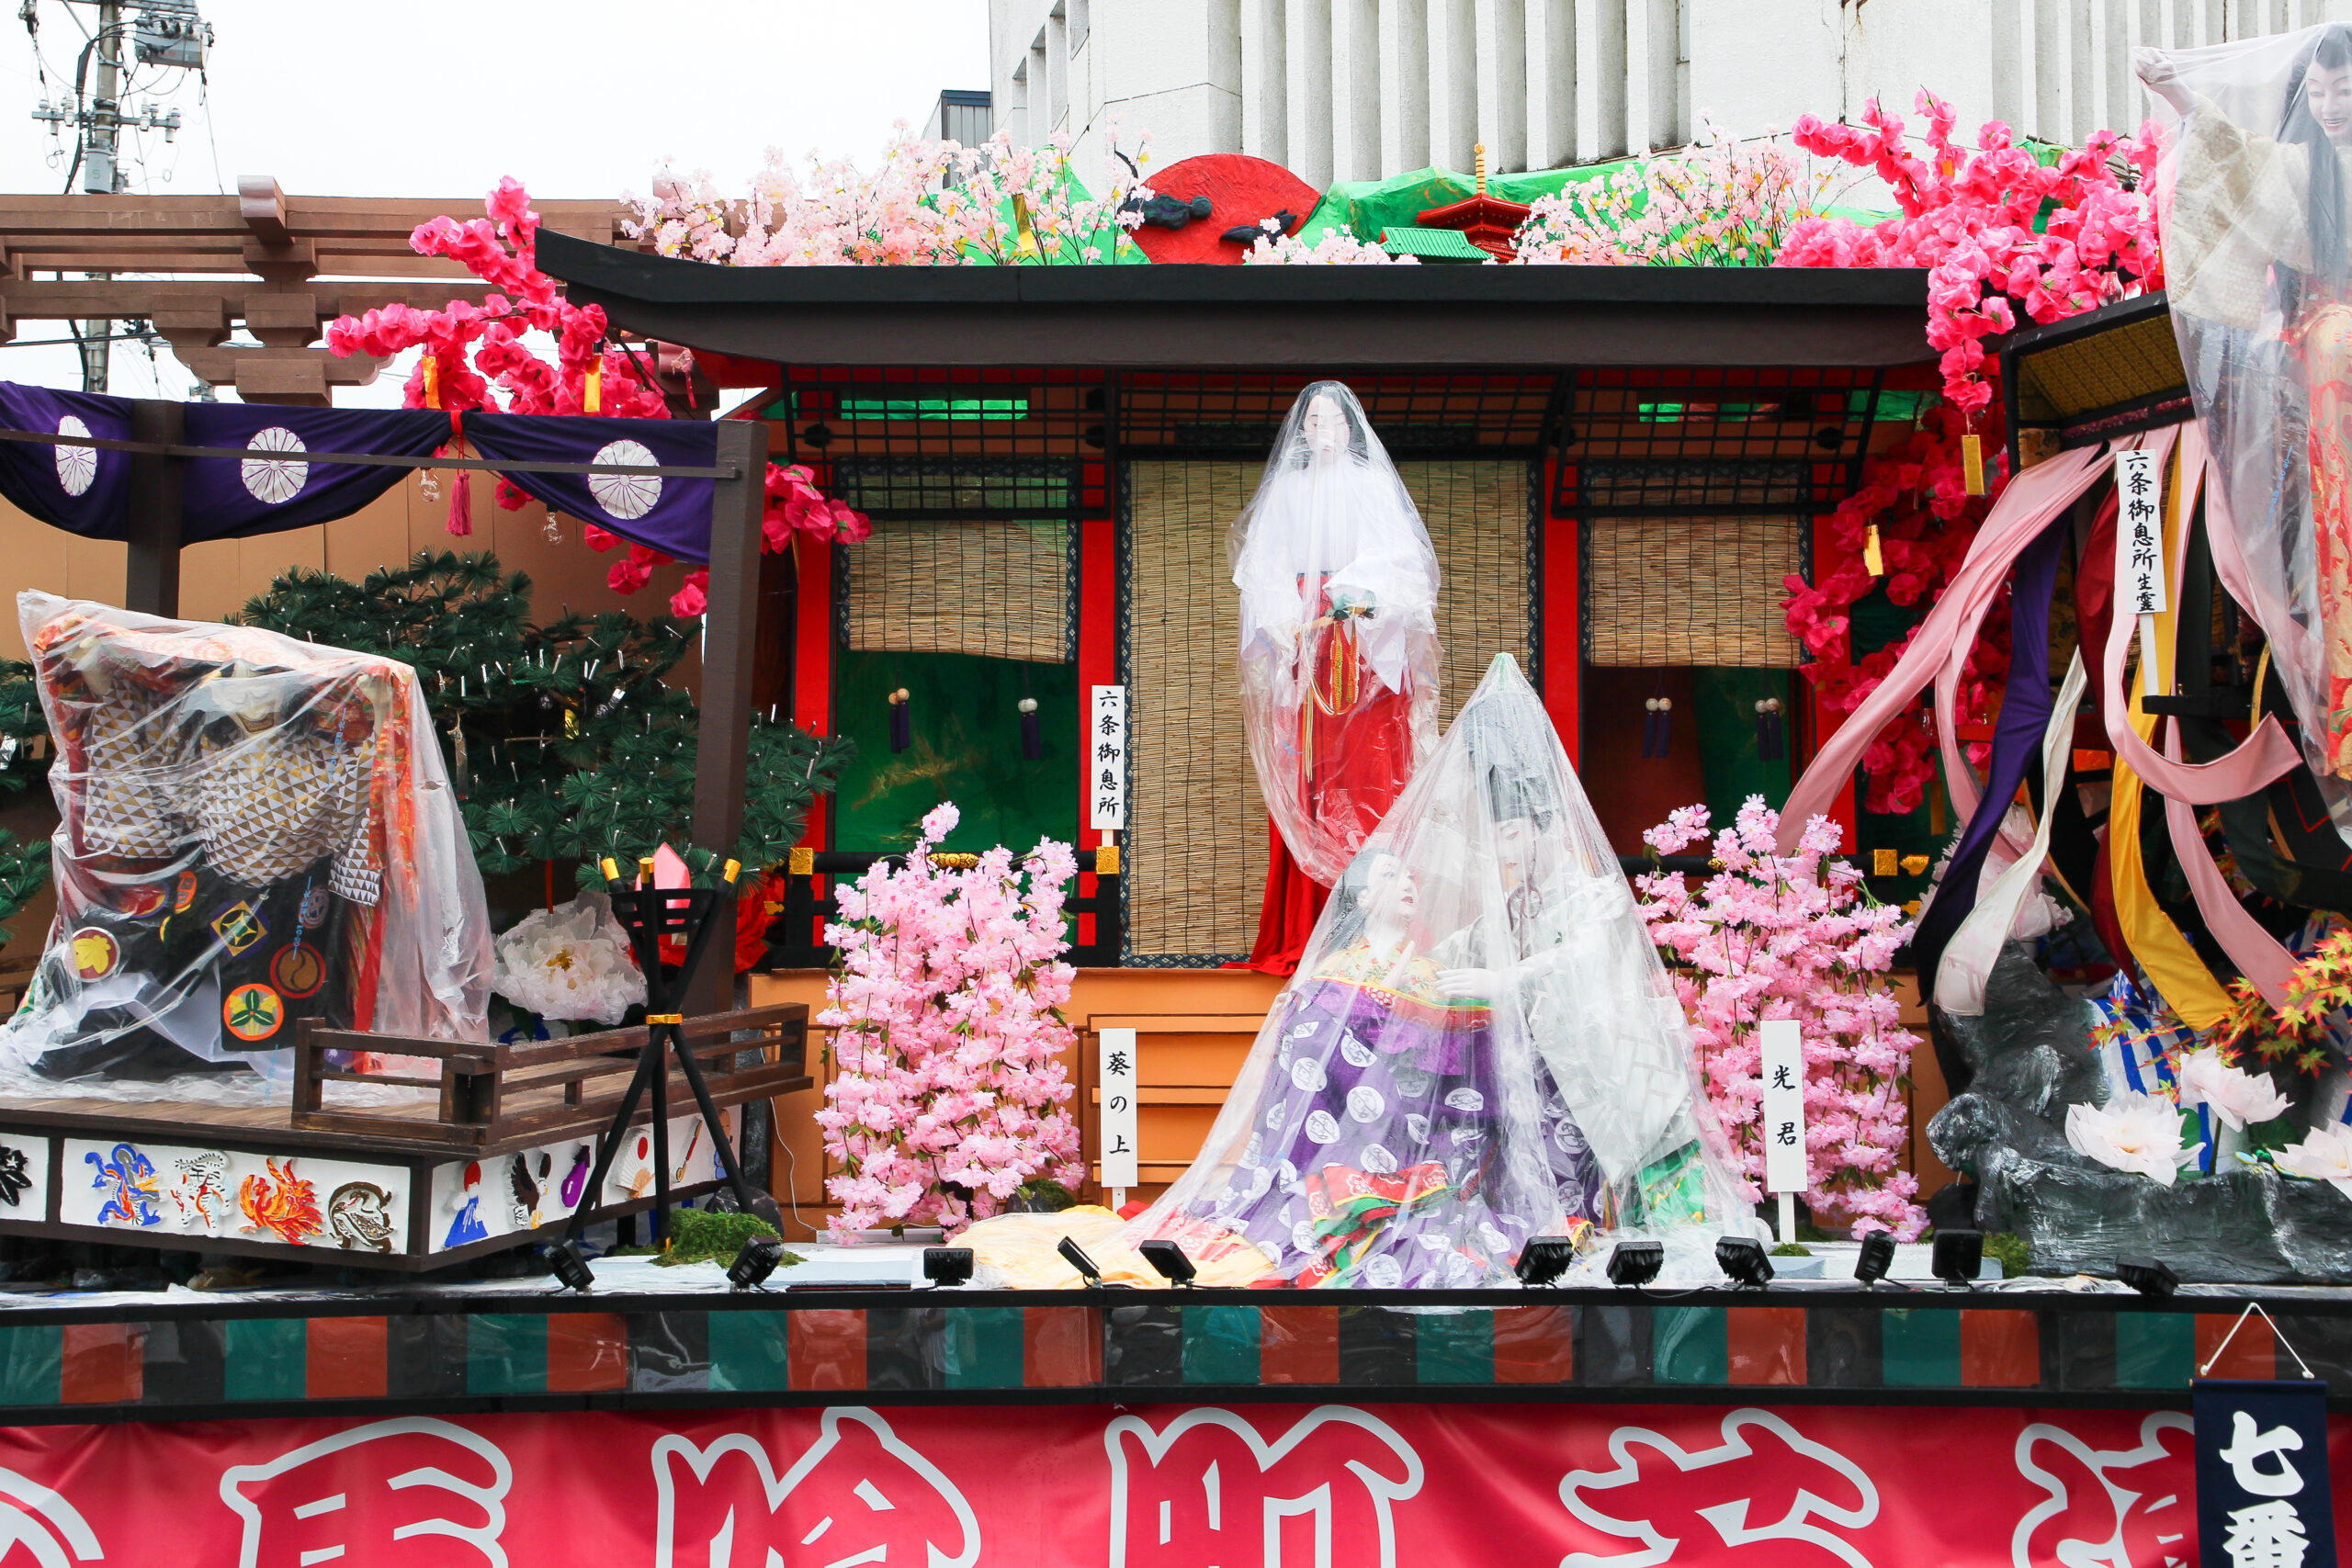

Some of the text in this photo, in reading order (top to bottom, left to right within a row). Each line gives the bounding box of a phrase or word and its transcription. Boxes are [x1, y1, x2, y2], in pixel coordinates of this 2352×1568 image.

[2126, 451, 2157, 612] 六条御息所生霊
[1097, 691, 1120, 818] 六条御息所
[1106, 1051, 1131, 1154] 葵の上
[1772, 1065, 1796, 1146] 光君
